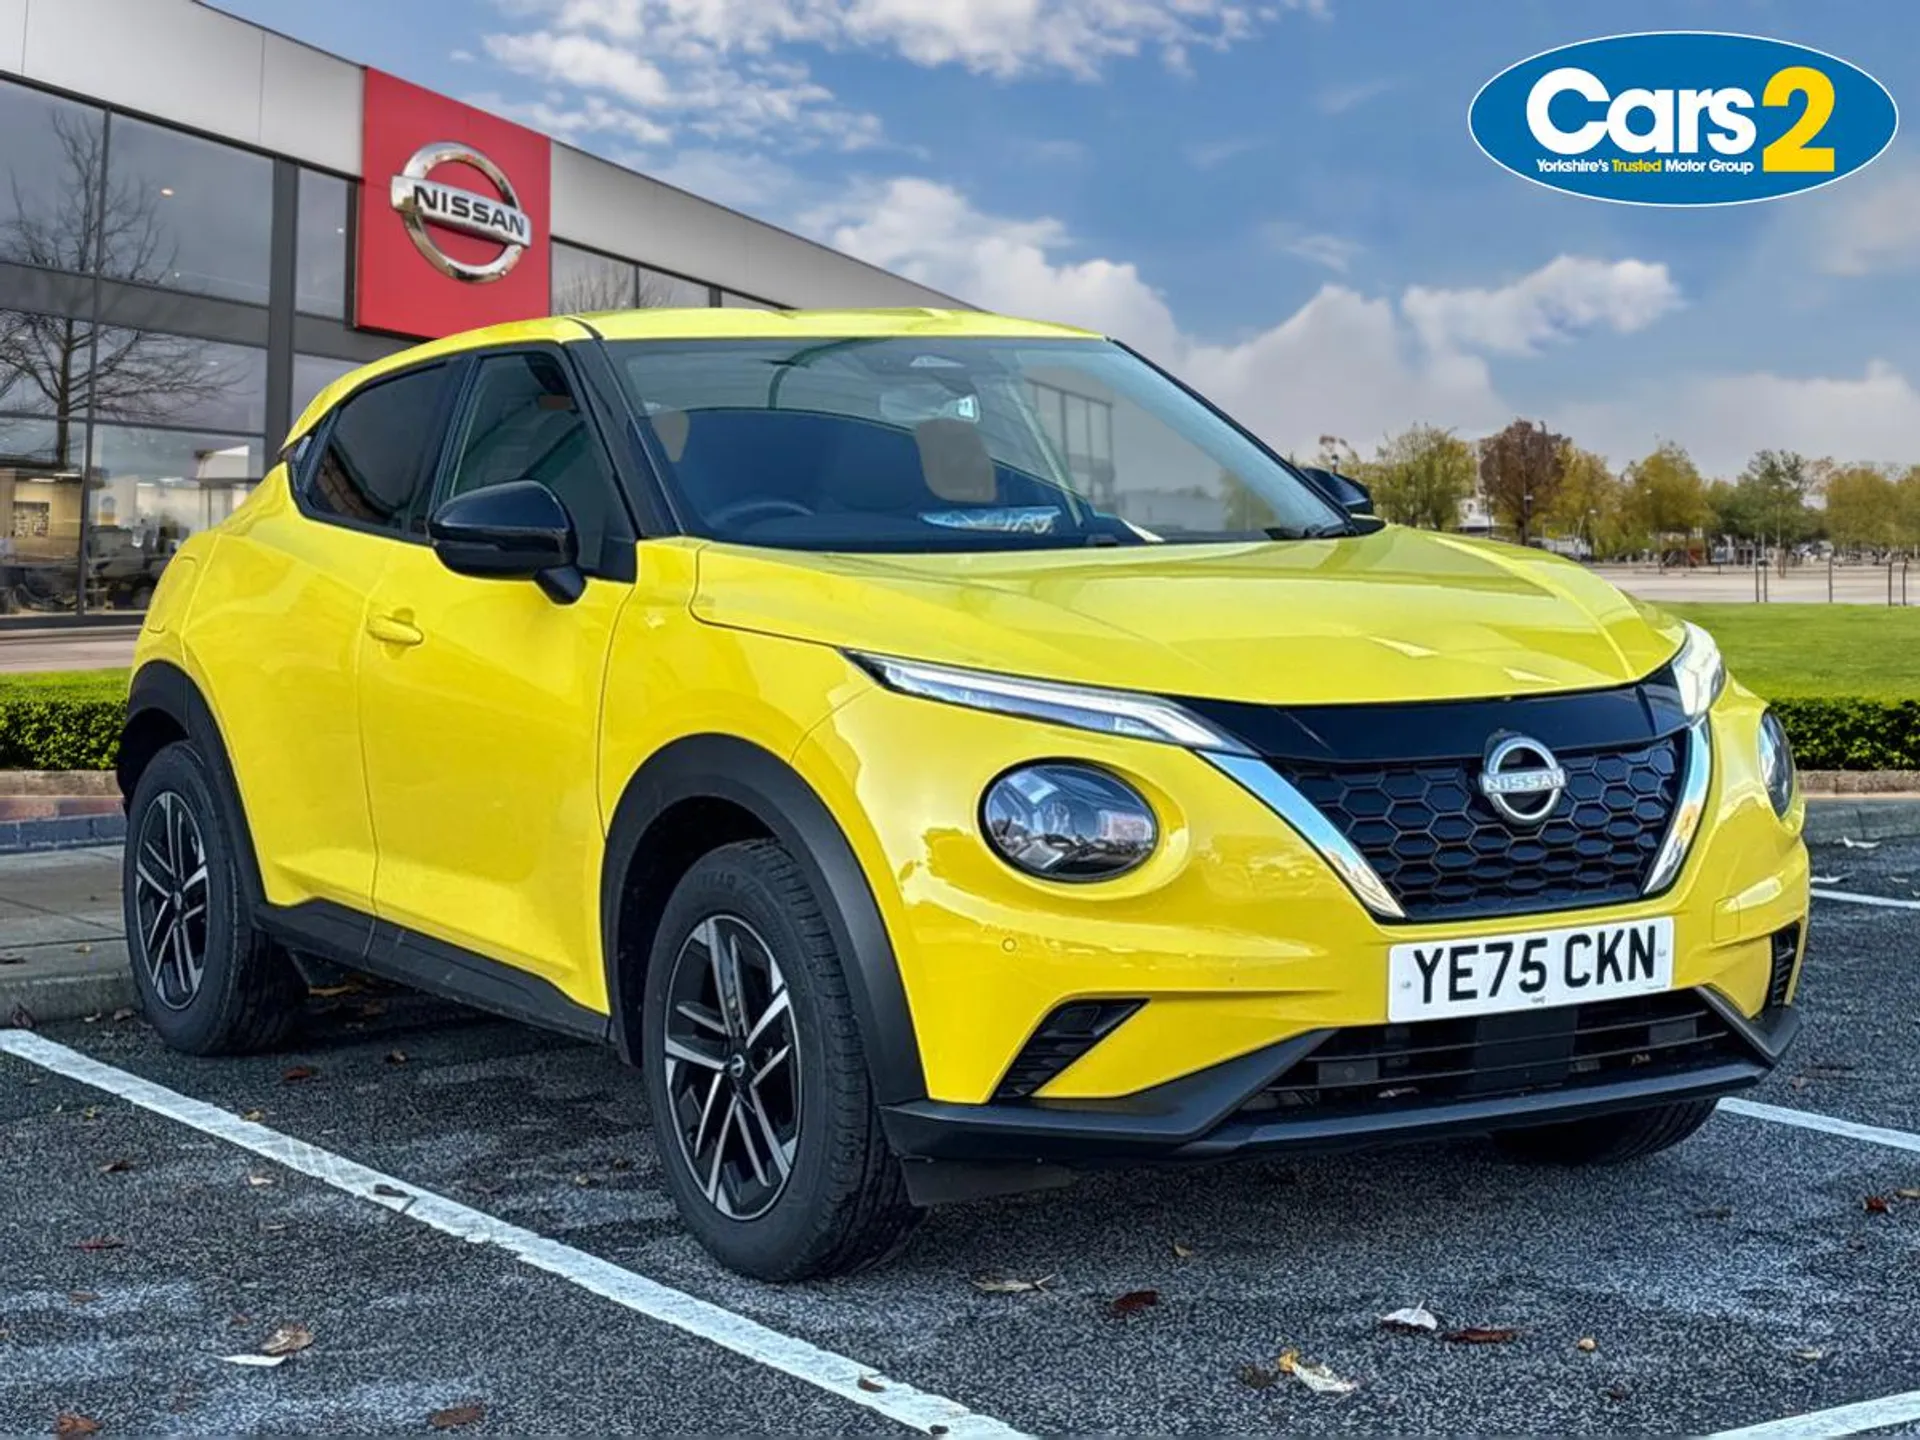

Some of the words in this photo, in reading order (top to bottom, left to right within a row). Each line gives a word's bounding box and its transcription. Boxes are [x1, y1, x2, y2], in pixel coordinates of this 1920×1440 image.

[413, 184, 525, 237] NISSAN
[1485, 769, 1565, 791] NISSAN
[1413, 937, 1549, 1004] YE75
[1563, 925, 1657, 989] CKN
